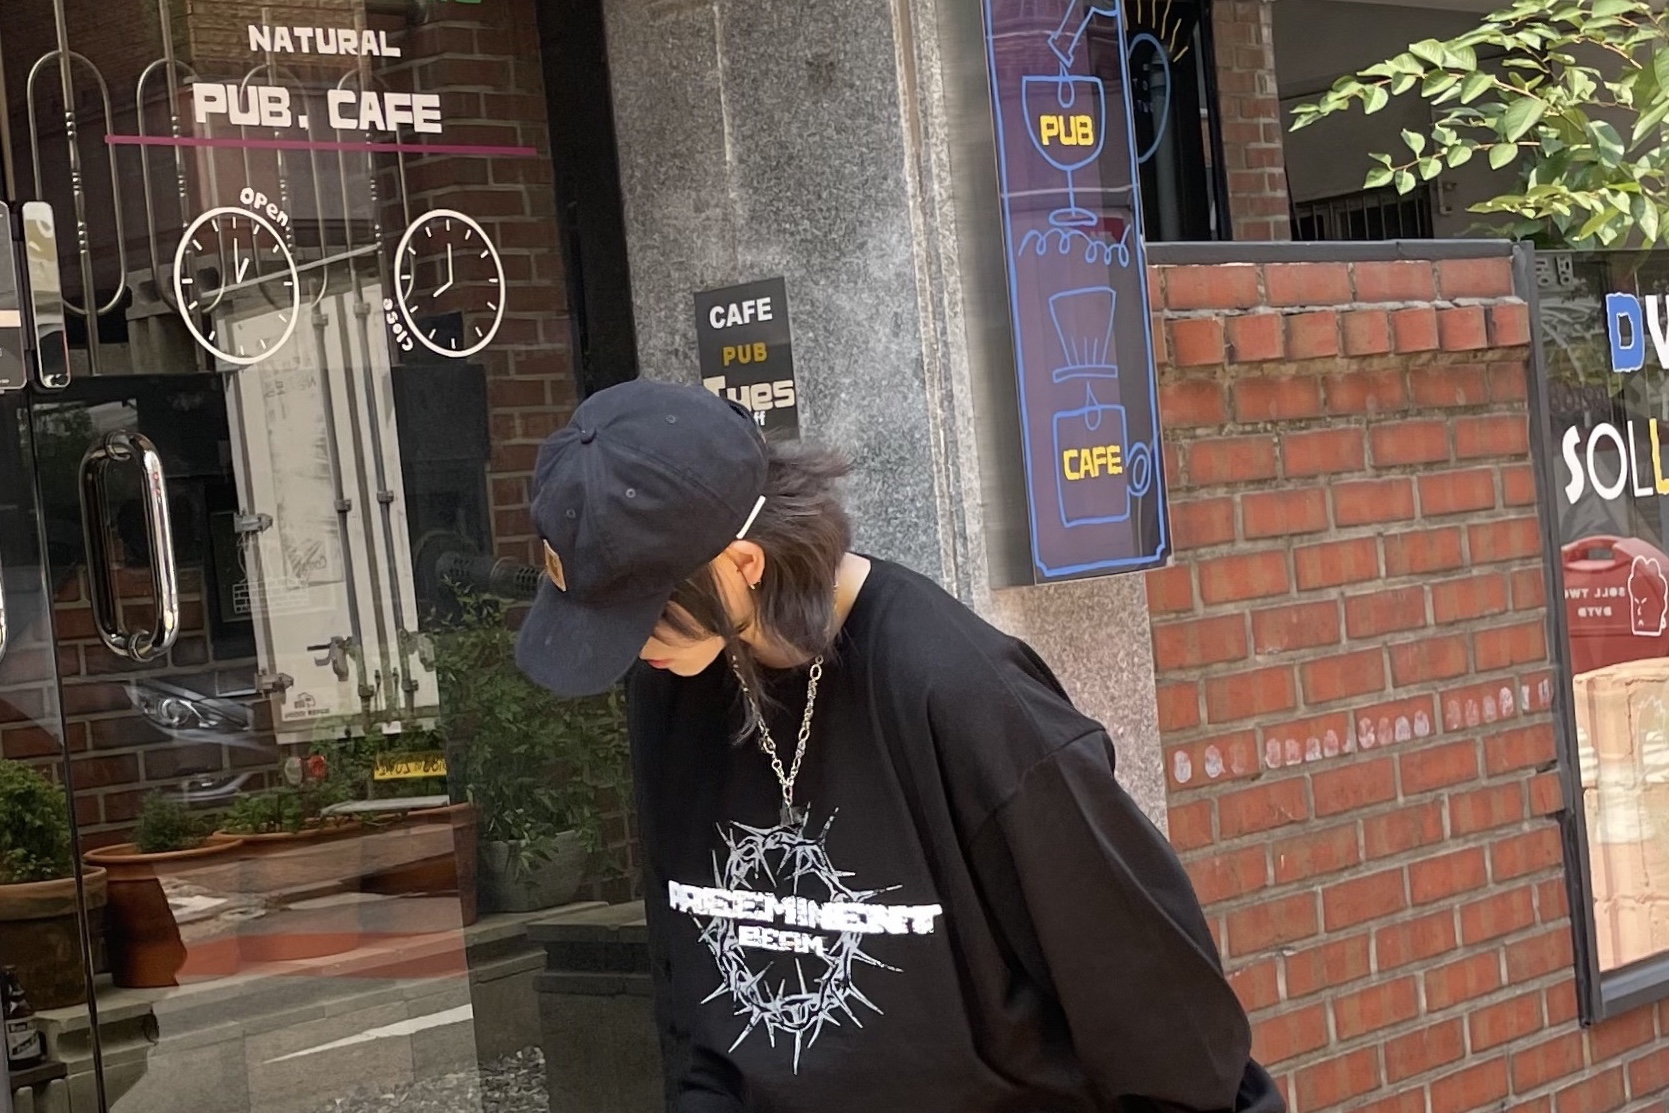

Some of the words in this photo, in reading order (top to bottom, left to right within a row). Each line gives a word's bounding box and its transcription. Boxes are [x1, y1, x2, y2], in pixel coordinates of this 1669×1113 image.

[248, 25, 401, 57] NATURAL
[327, 89, 443, 133] CAFE
[1040, 114, 1094, 146] PUB
[709, 297, 773, 329] CAFE
[722, 342, 768, 366] PUB
[1063, 445, 1123, 480] CAFE
